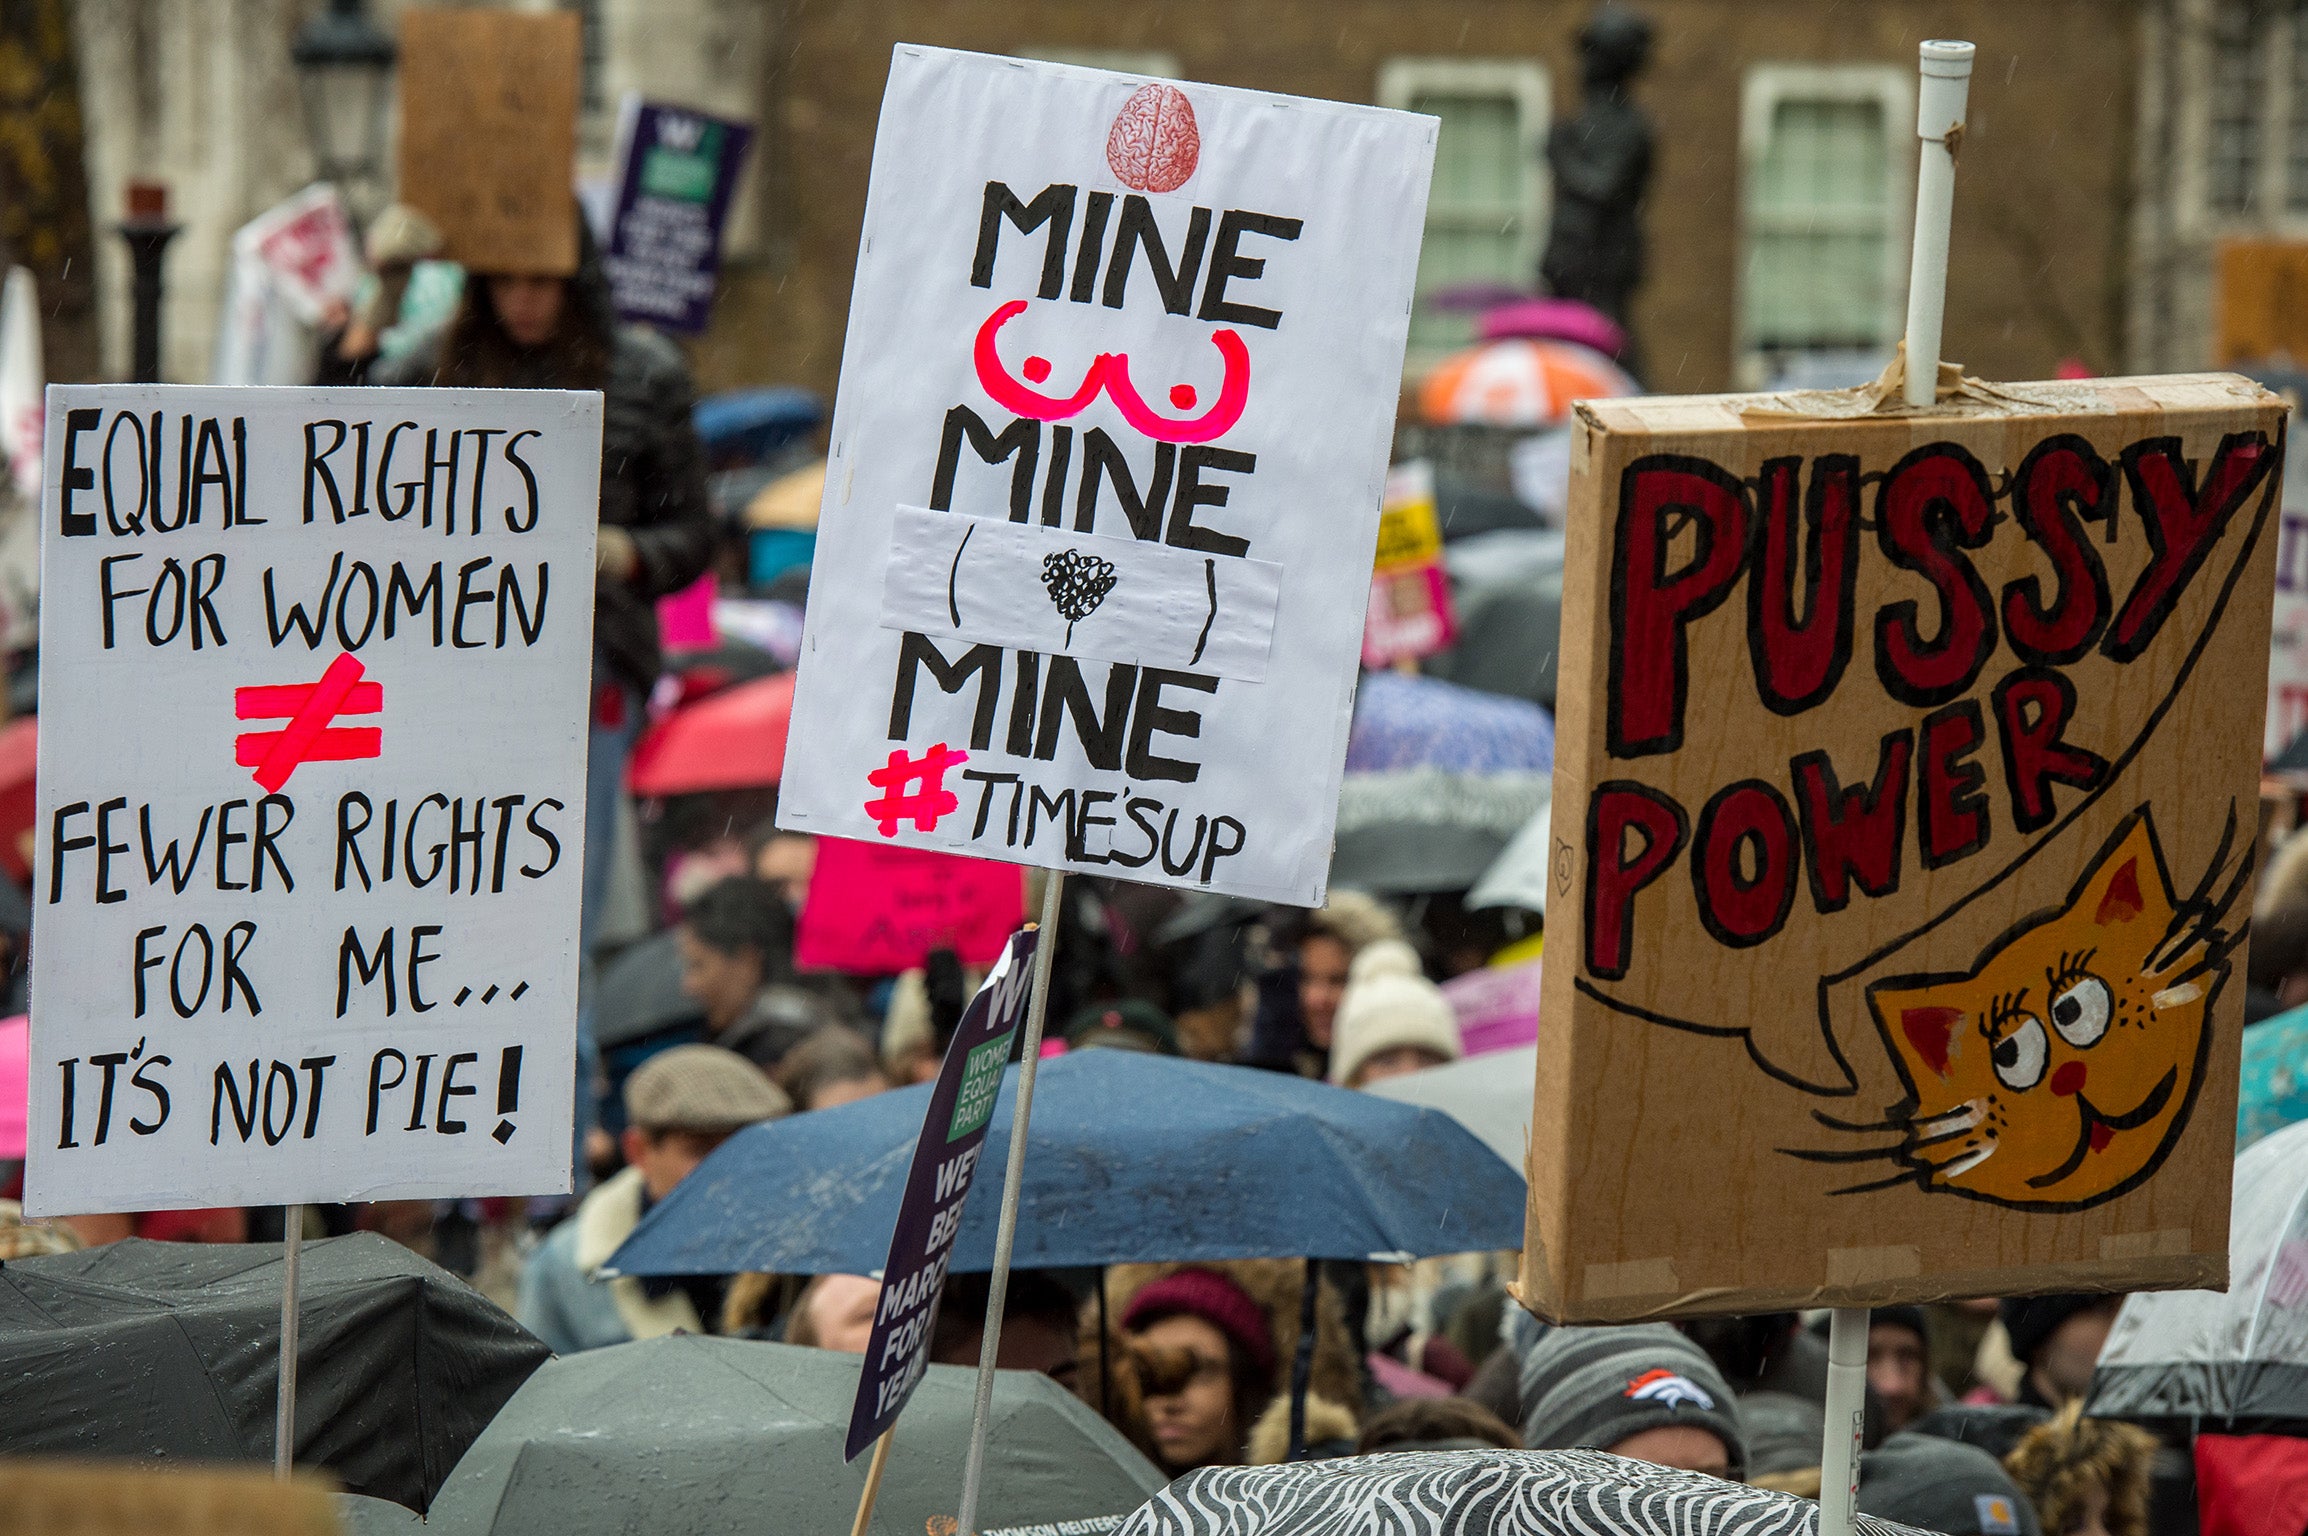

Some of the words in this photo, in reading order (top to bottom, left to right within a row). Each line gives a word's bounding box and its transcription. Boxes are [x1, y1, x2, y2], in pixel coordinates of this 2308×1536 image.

[971, 181, 1304, 329] MINE
[61, 408, 268, 537] EQUAL
[302, 419, 542, 537] RIGHTS
[930, 404, 1257, 558] MINE
[100, 552, 228, 650] FOR
[263, 551, 549, 652] WOMEN
[1606, 431, 2277, 758] PUSSY
[887, 631, 1220, 782] MINE
[49, 792, 295, 904] FEWER
[335, 790, 565, 896] RIGHTS
[1586, 664, 2112, 981] POWER
[134, 921, 262, 1019] FOR
[336, 924, 530, 1019] ME...
[57, 1036, 173, 1150] IT'S
[210, 1055, 336, 1146] NOT
[961, 1068, 1000, 1104] EQUA
[969, 1040, 1010, 1078] WOME
[878, 1251, 948, 1327] MARC
